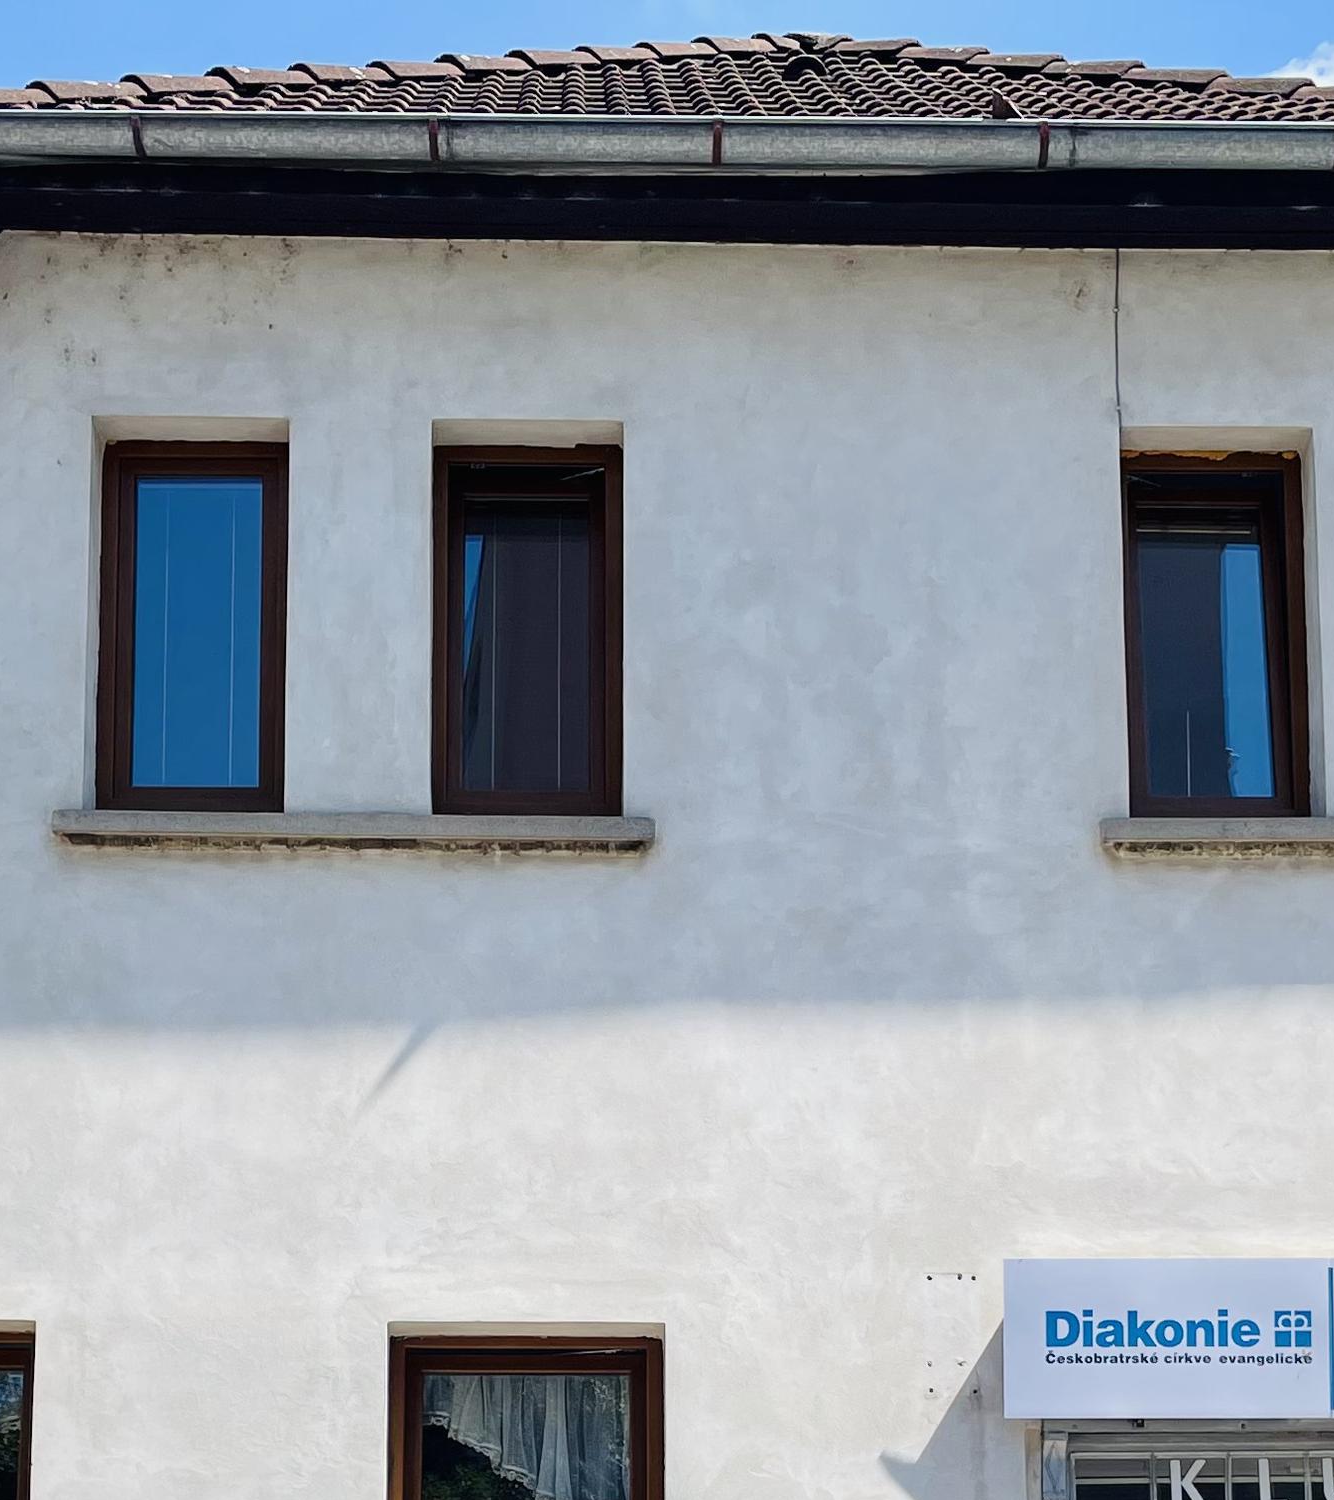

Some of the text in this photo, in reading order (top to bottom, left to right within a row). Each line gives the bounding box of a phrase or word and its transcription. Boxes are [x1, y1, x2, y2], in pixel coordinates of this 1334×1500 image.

[1045, 1309, 1261, 1348] Diakonie
[1045, 1350, 1159, 1365] Českobratrské
[1163, 1351, 1212, 1365] církve
